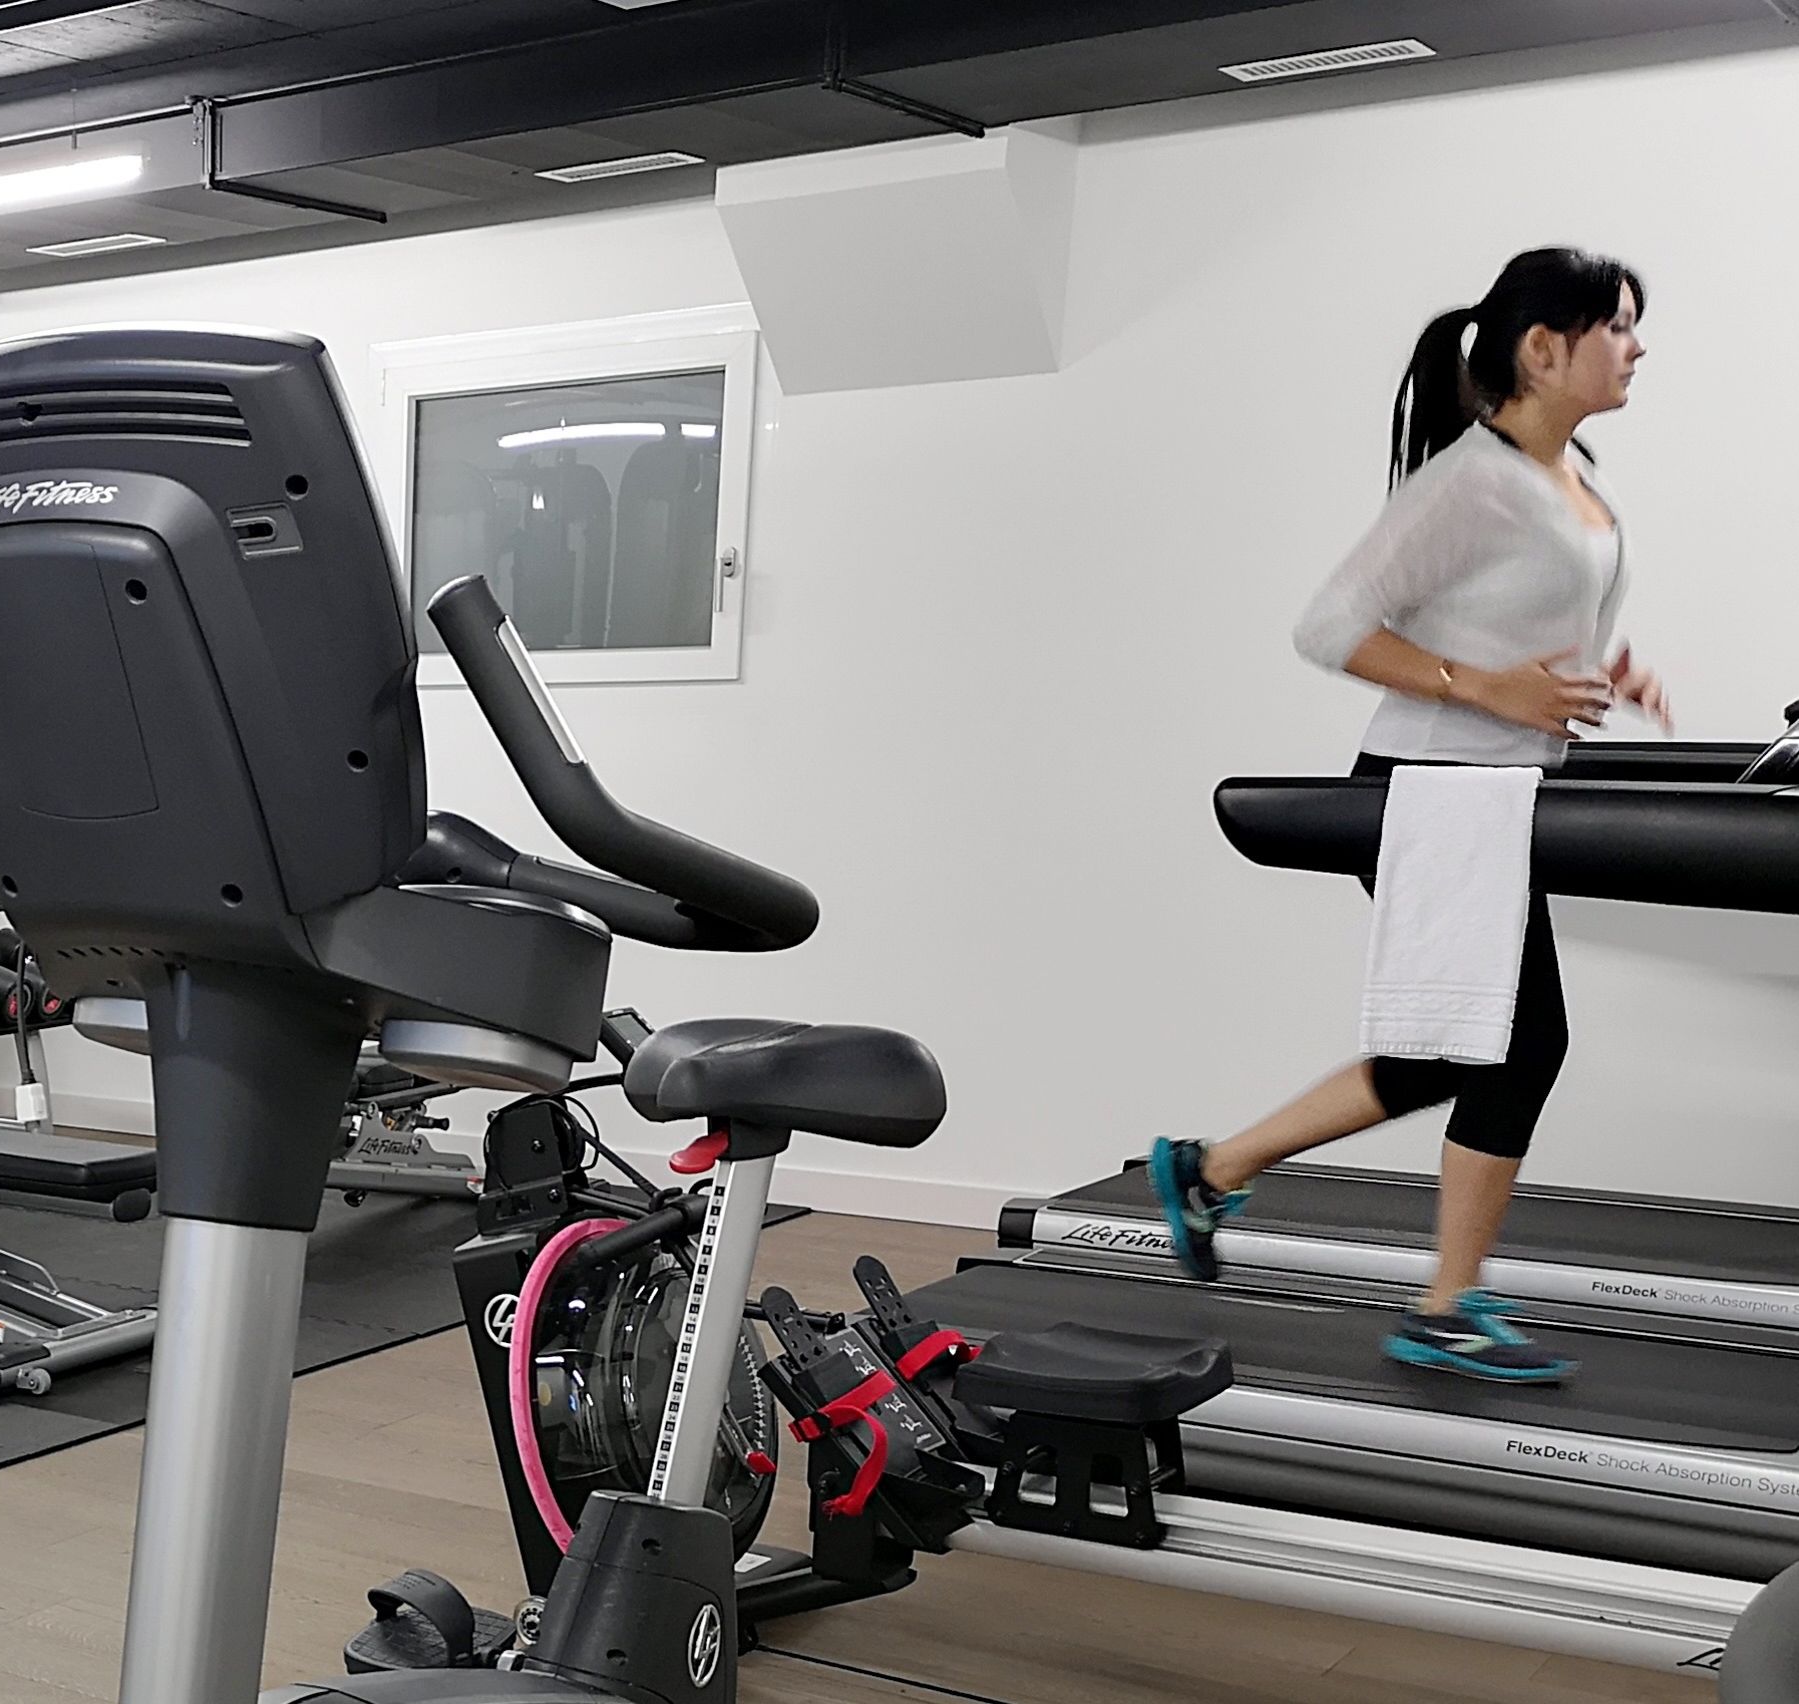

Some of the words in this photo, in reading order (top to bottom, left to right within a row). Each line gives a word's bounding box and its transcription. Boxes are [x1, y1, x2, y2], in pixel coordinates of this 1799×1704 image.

[1108, 1230, 1176, 1249] Fitne
[1591, 1281, 1658, 1298] FlexDeck
[1664, 1289, 1708, 1305] Shock
[1710, 1297, 1789, 1313] Absorption
[1506, 1440, 1588, 1464] FlexDeck
[1597, 1454, 1651, 1473] Shock
[1655, 1464, 1752, 1489] Absorption
[1757, 1477, 1799, 1496] Syst
